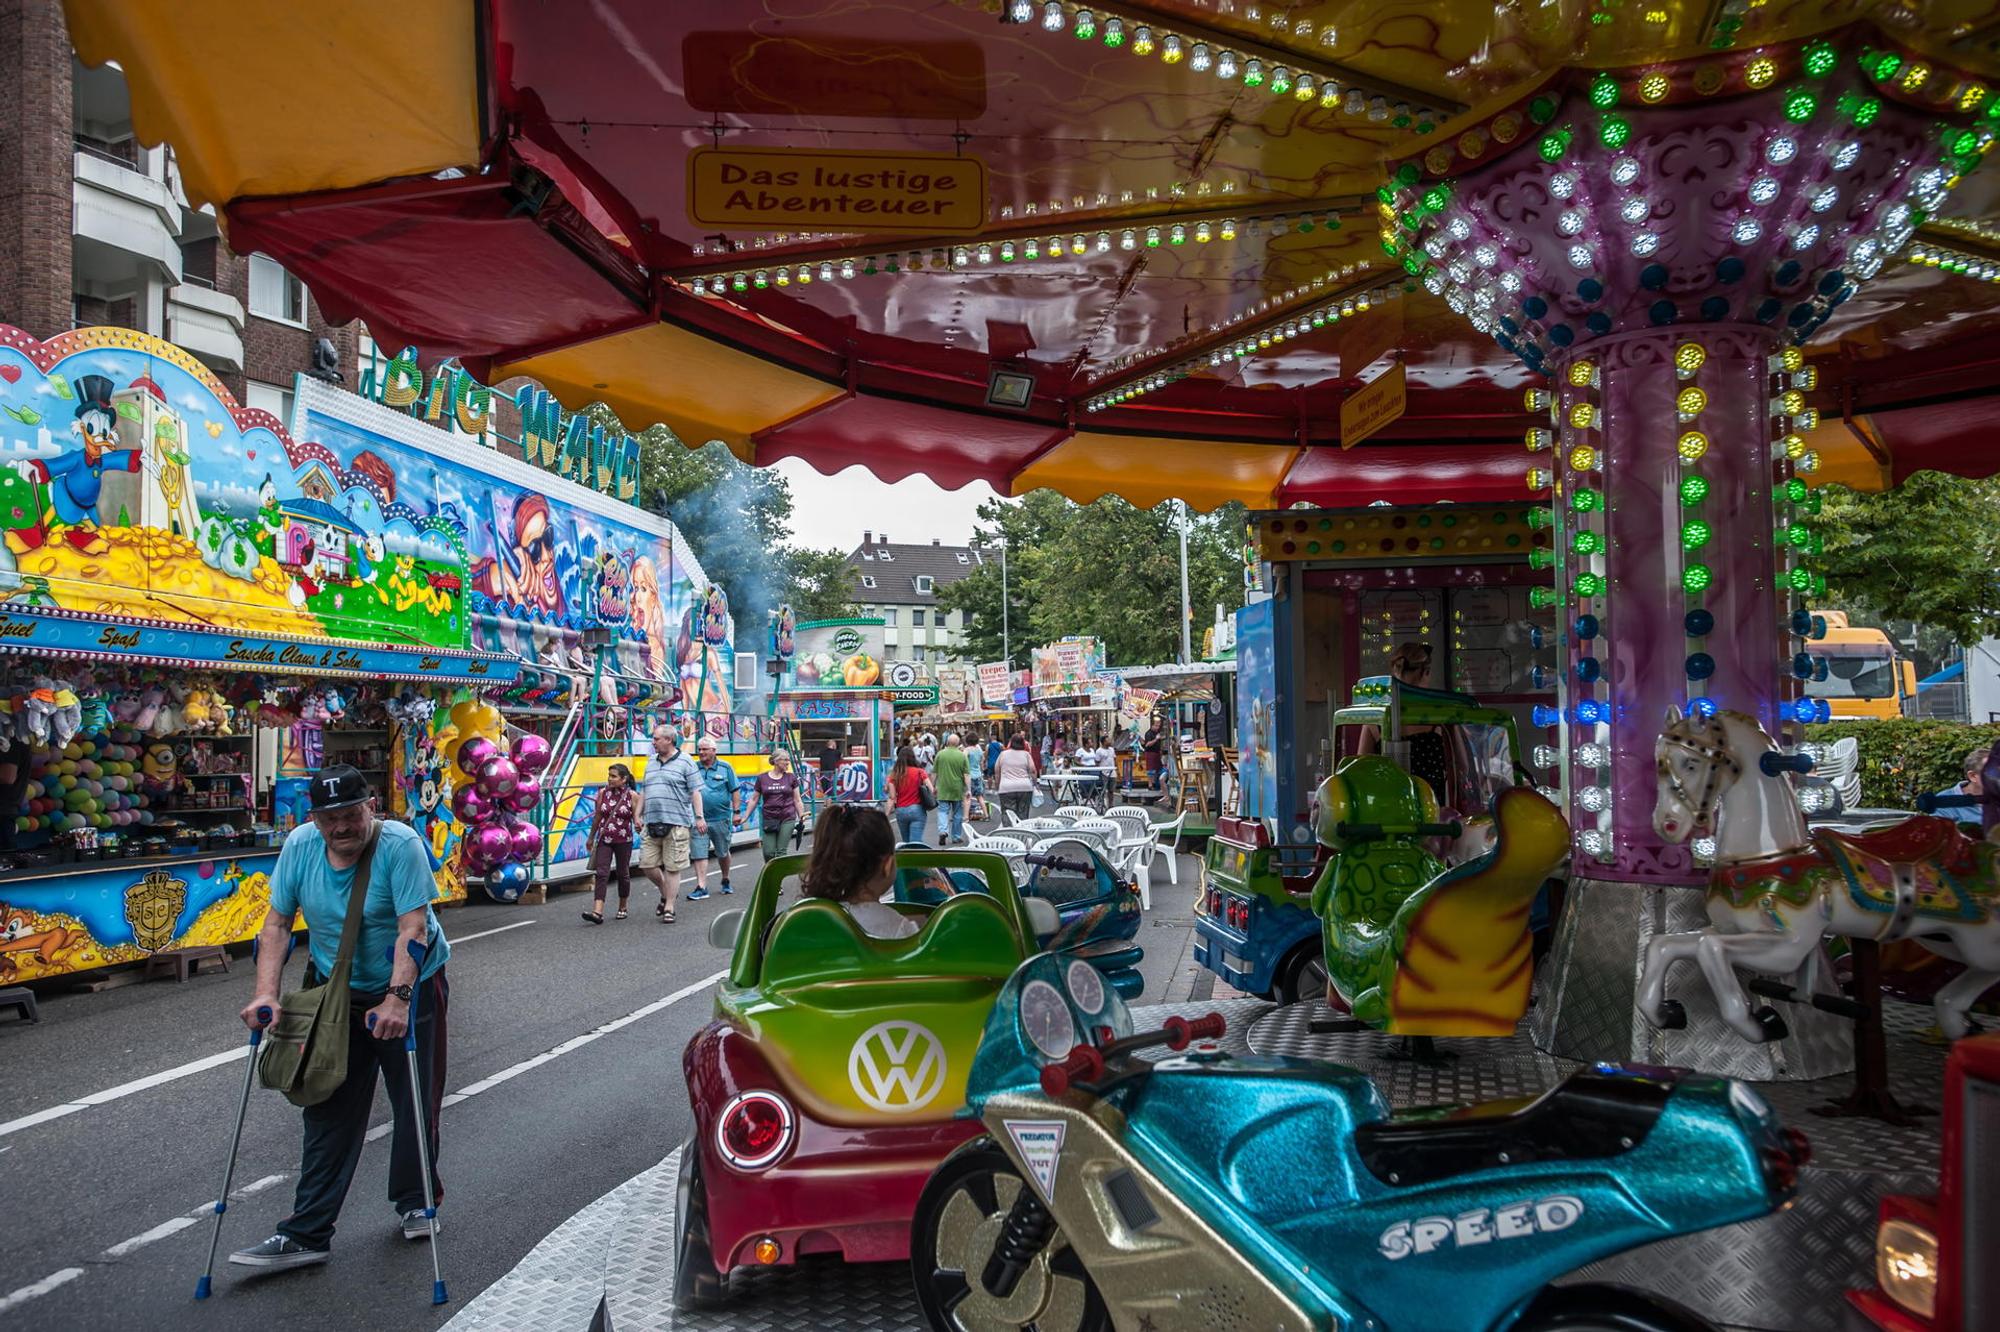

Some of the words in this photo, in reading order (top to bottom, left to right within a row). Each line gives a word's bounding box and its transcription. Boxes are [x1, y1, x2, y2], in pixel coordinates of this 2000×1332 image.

[721, 163, 798, 187] Das
[814, 167, 957, 194] lustige
[724, 190, 955, 215] Abenteuer
[516, 384, 642, 500] WAVE
[98, 626, 140, 649] Spaß
[224, 640, 275, 662] Sascha
[279, 645, 316, 665] Claus
[320, 650, 332, 665] &
[332, 650, 363, 669] Sohn
[795, 701, 857, 717] KASSE
[322, 777, 340, 798] T
[1377, 1193, 1585, 1261] SPEED
